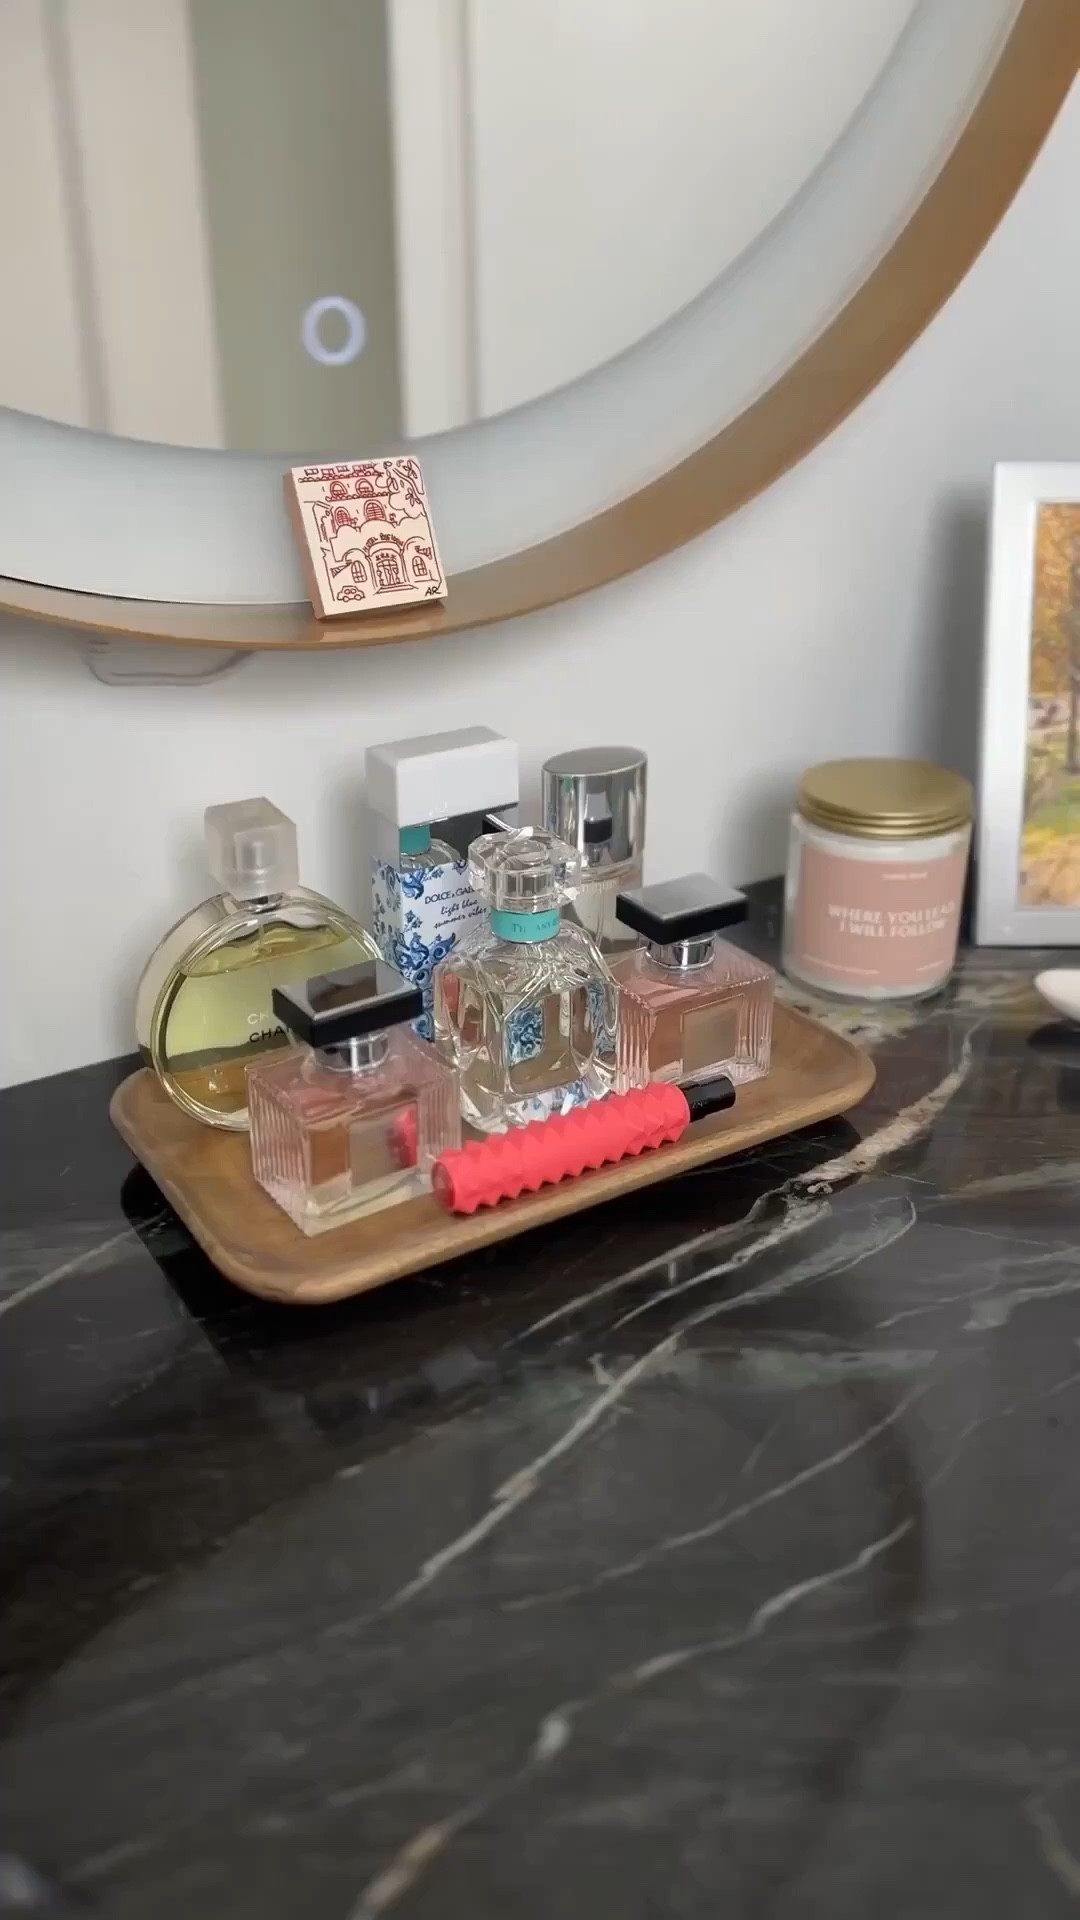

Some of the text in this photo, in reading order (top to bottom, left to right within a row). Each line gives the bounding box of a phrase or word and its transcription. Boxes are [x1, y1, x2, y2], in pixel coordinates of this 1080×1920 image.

[440, 898, 479, 917] light blue
[828, 903, 881, 923] WHERE
[887, 910, 923, 924] YOU
[839, 919, 945, 937] I WILL FOLLOW
